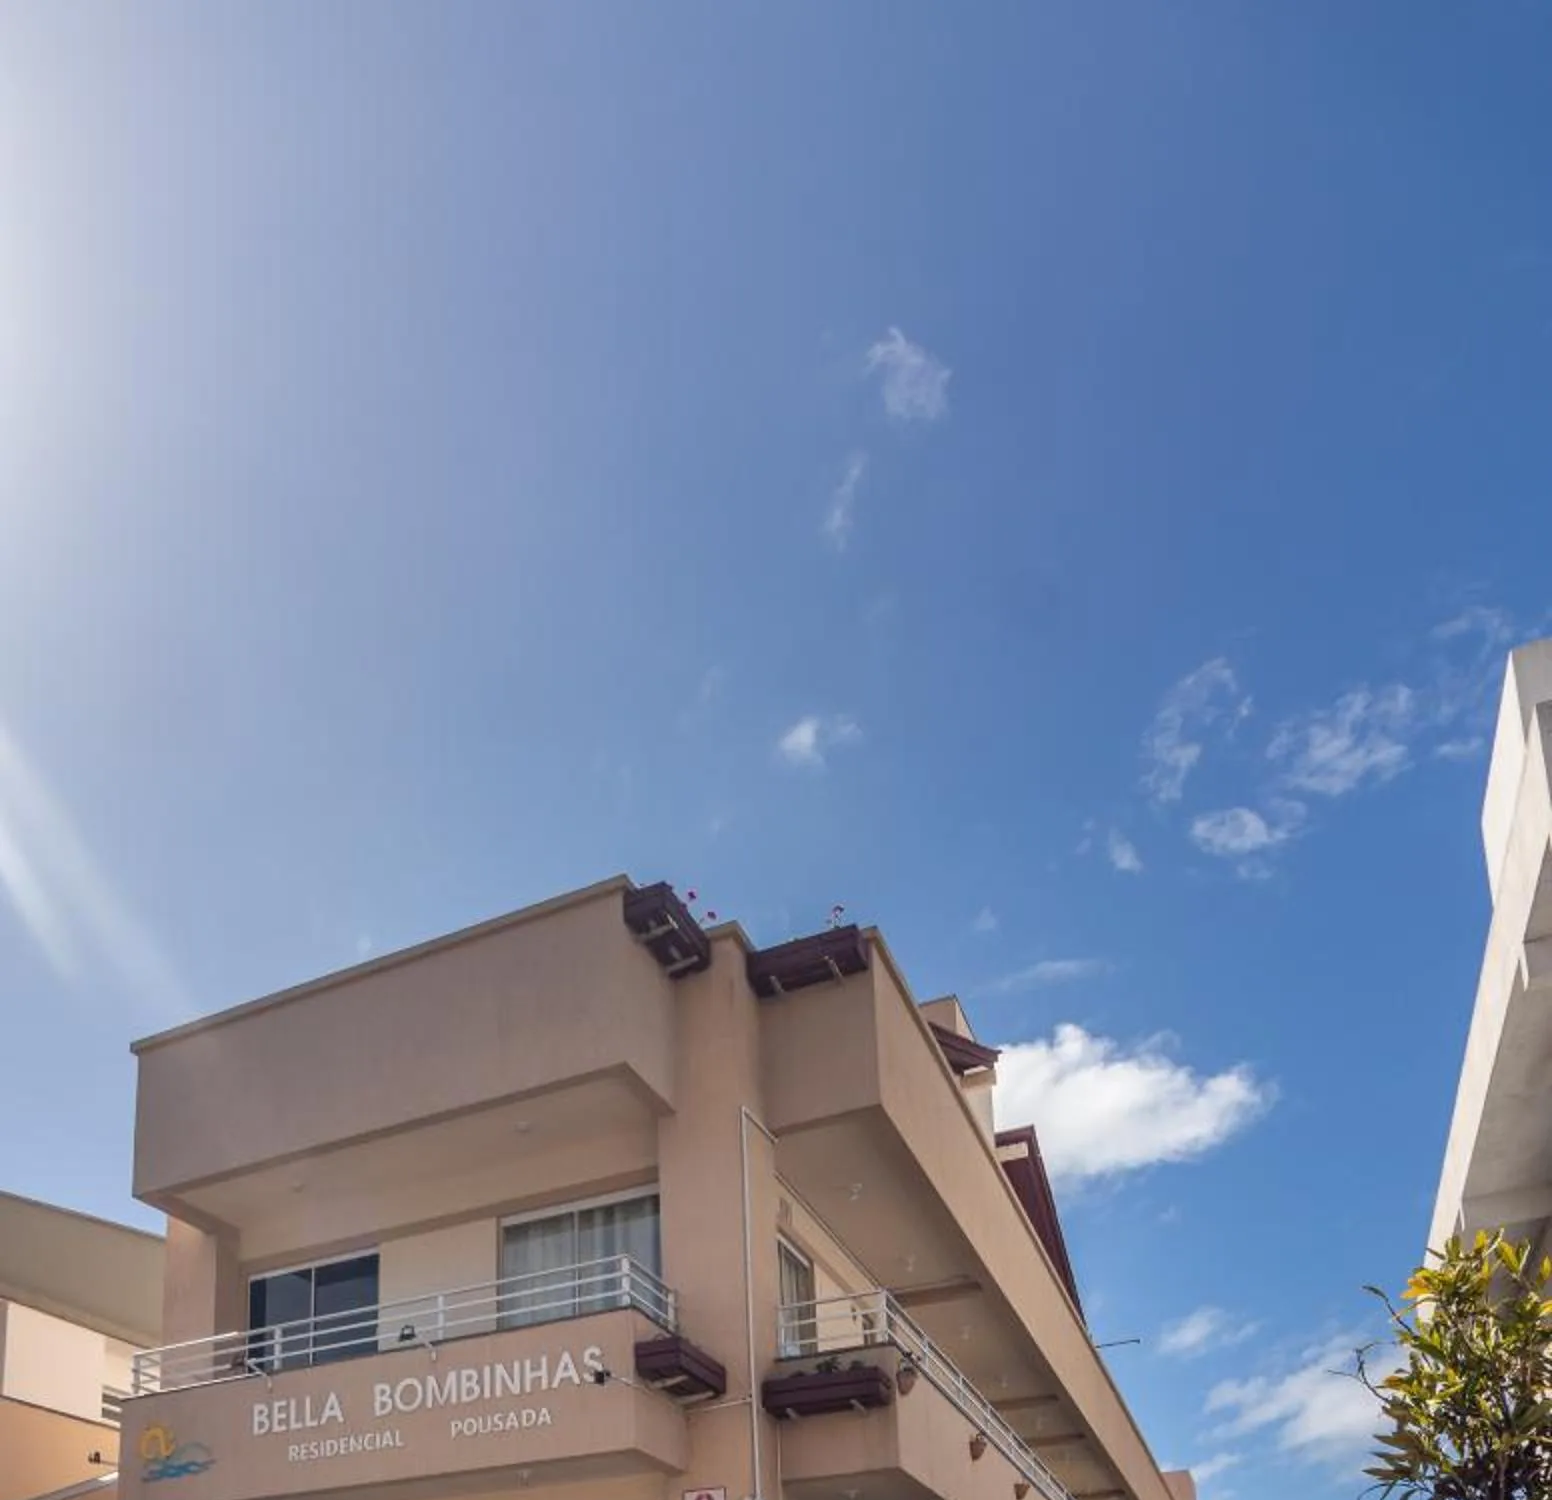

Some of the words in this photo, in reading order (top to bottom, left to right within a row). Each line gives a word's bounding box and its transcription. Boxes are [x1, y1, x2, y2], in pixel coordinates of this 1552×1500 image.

[252, 1391, 345, 1436] BELLA
[373, 1346, 605, 1417] BOMBINHAS
[288, 1429, 405, 1462] RESIDENCIAL
[450, 1407, 552, 1438] POUSADA
